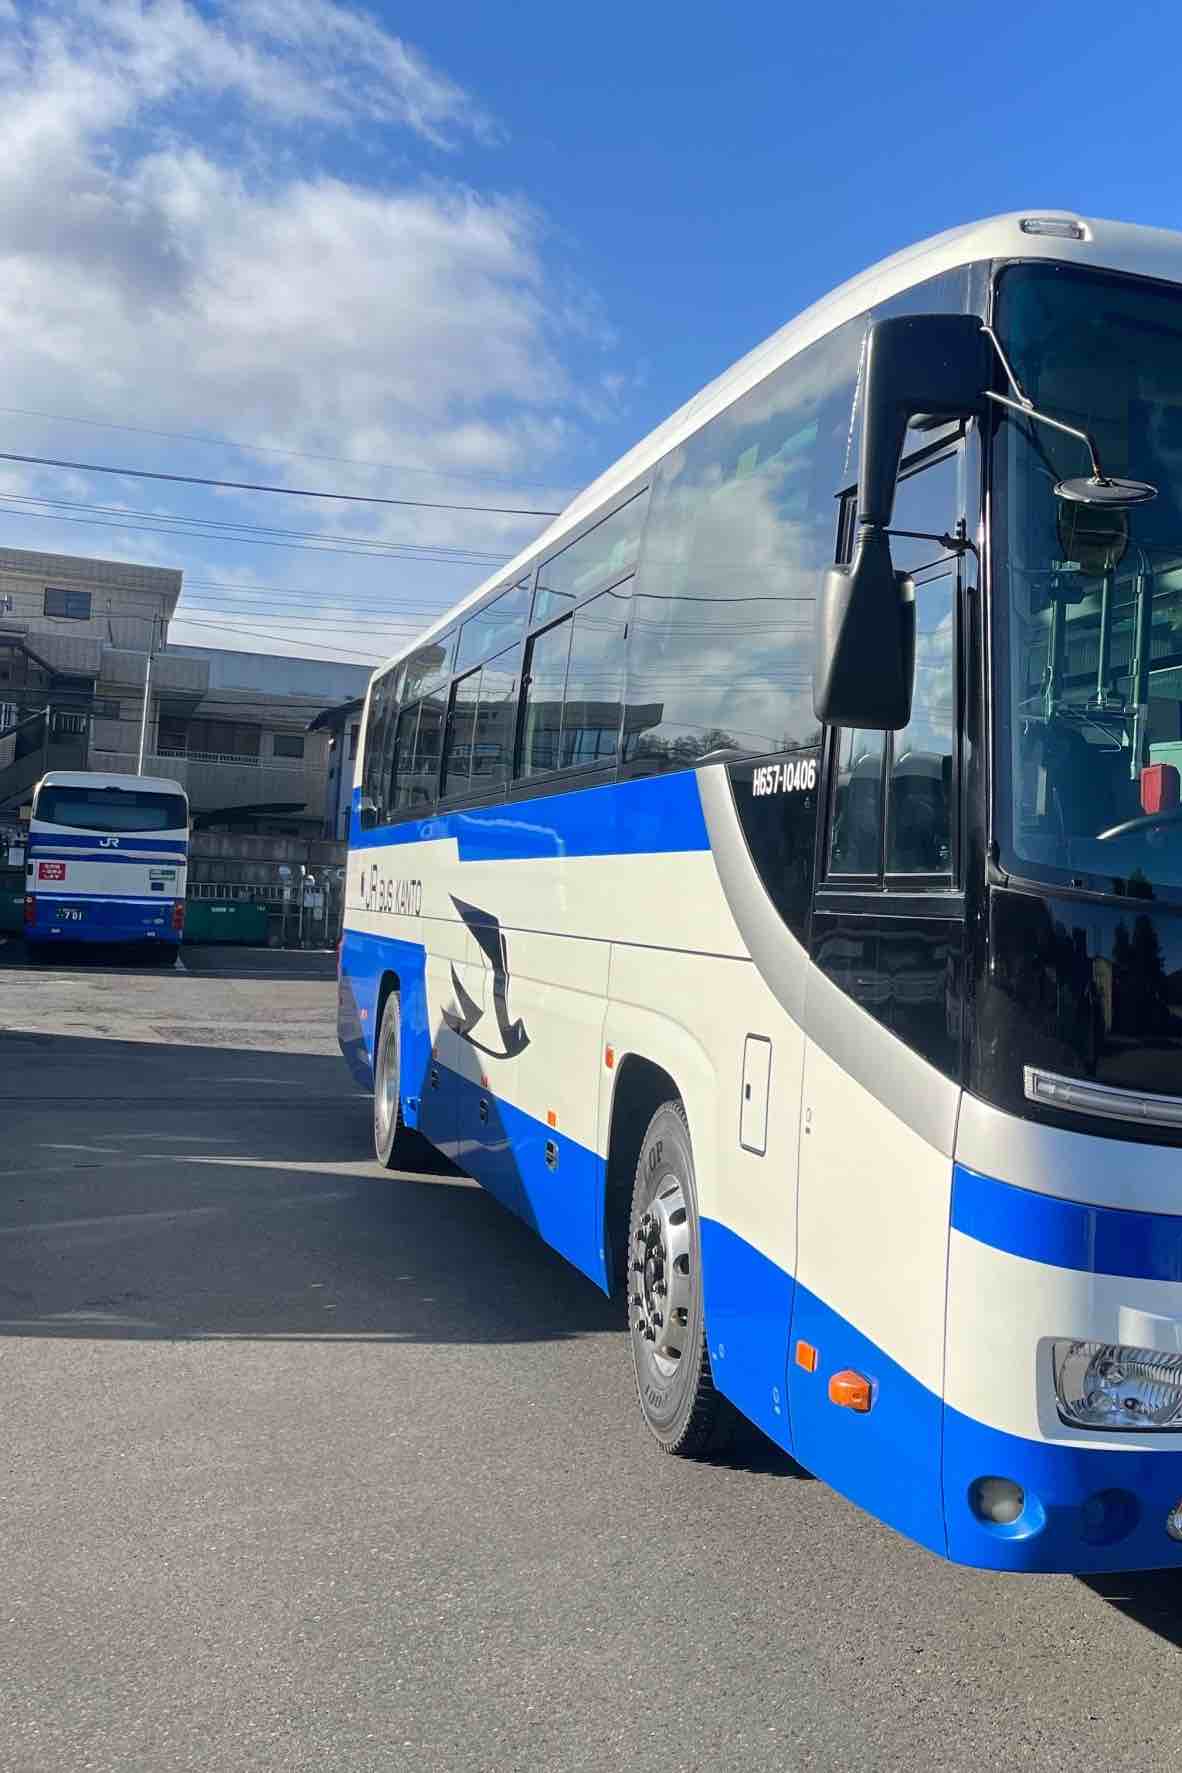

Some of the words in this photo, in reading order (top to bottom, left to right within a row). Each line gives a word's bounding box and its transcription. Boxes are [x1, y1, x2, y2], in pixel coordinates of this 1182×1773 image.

[752, 758, 817, 797] H657-10406
[99, 837, 120, 848] JR
[394, 879, 423, 917] KANTO
